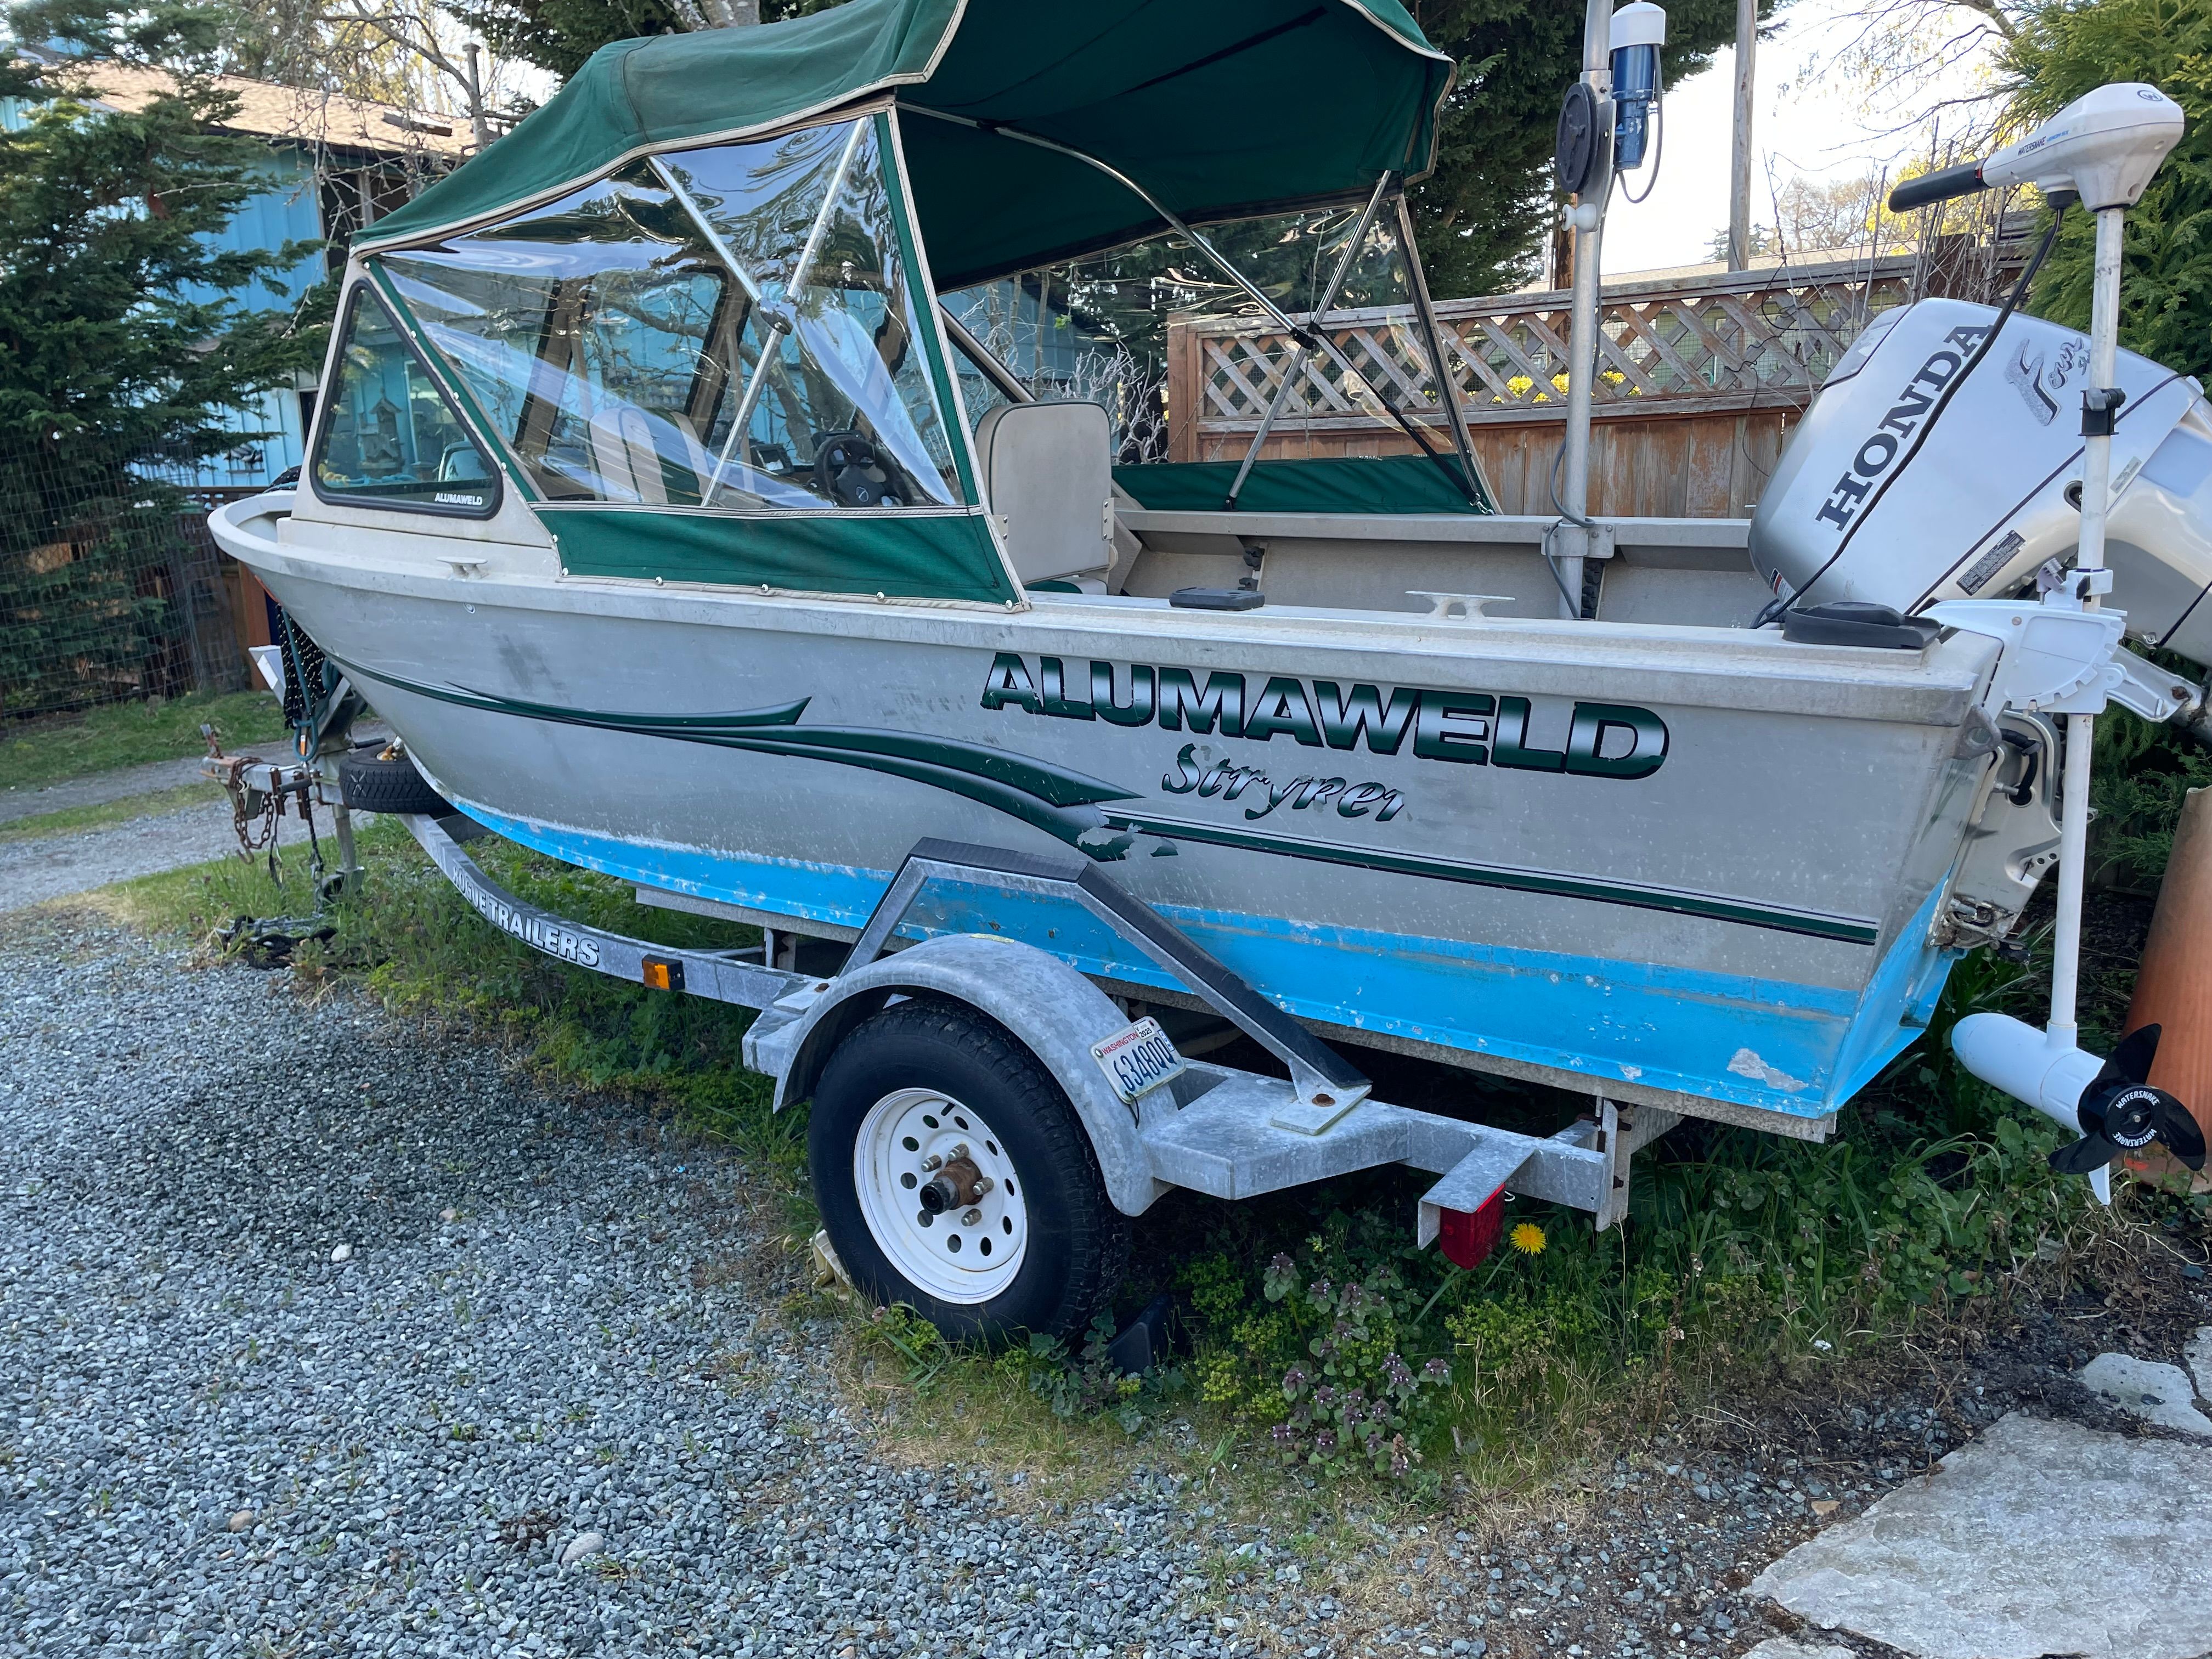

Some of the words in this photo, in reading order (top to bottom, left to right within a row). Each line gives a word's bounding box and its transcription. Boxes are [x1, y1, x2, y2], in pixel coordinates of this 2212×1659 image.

[1815, 326, 1993, 532] HONDA
[435, 493, 483, 506] ALUMAWELD
[980, 652, 1669, 781] ALUMAWELD
[453, 867, 487, 916] ROGUE
[489, 895, 600, 967] TRAILERS
[1101, 1032, 1138, 1055] WASHINGTON
[1139, 1027, 1153, 1037] 2025
[1113, 1036, 1177, 1092] 6348QQ
[2115, 1091, 2160, 1109] WATERSNAKE
[2113, 1128, 2158, 1147] WATERSNAKE
